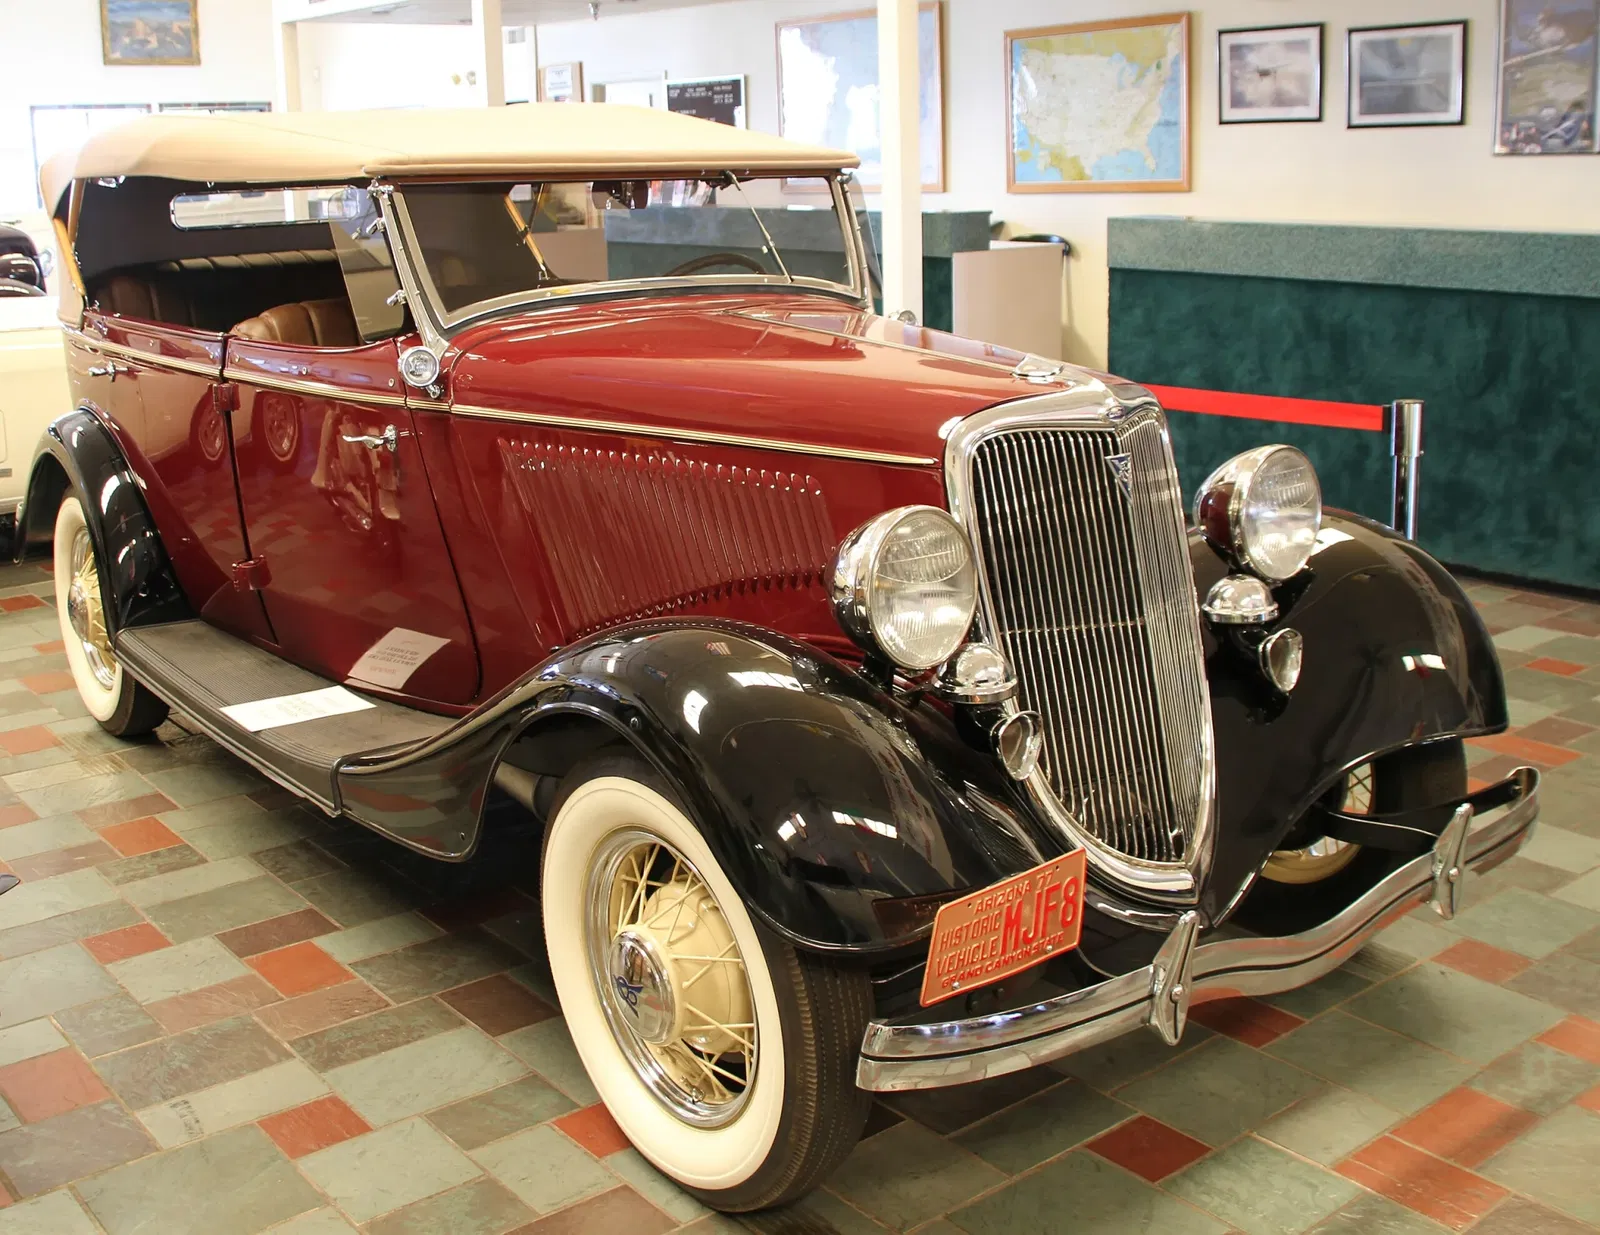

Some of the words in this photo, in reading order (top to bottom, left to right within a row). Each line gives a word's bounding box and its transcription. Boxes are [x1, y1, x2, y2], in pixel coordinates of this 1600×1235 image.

[974, 880, 1032, 915] ARIZONA
[1036, 871, 1055, 889] 77
[939, 911, 1001, 952] HISTORIC
[1000, 877, 1080, 954] MJF8
[936, 936, 999, 978] VEHICLE
[941, 966, 983, 988] GRAND
[985, 946, 1030, 973] CANYON
[1030, 931, 1064, 954] STATE
